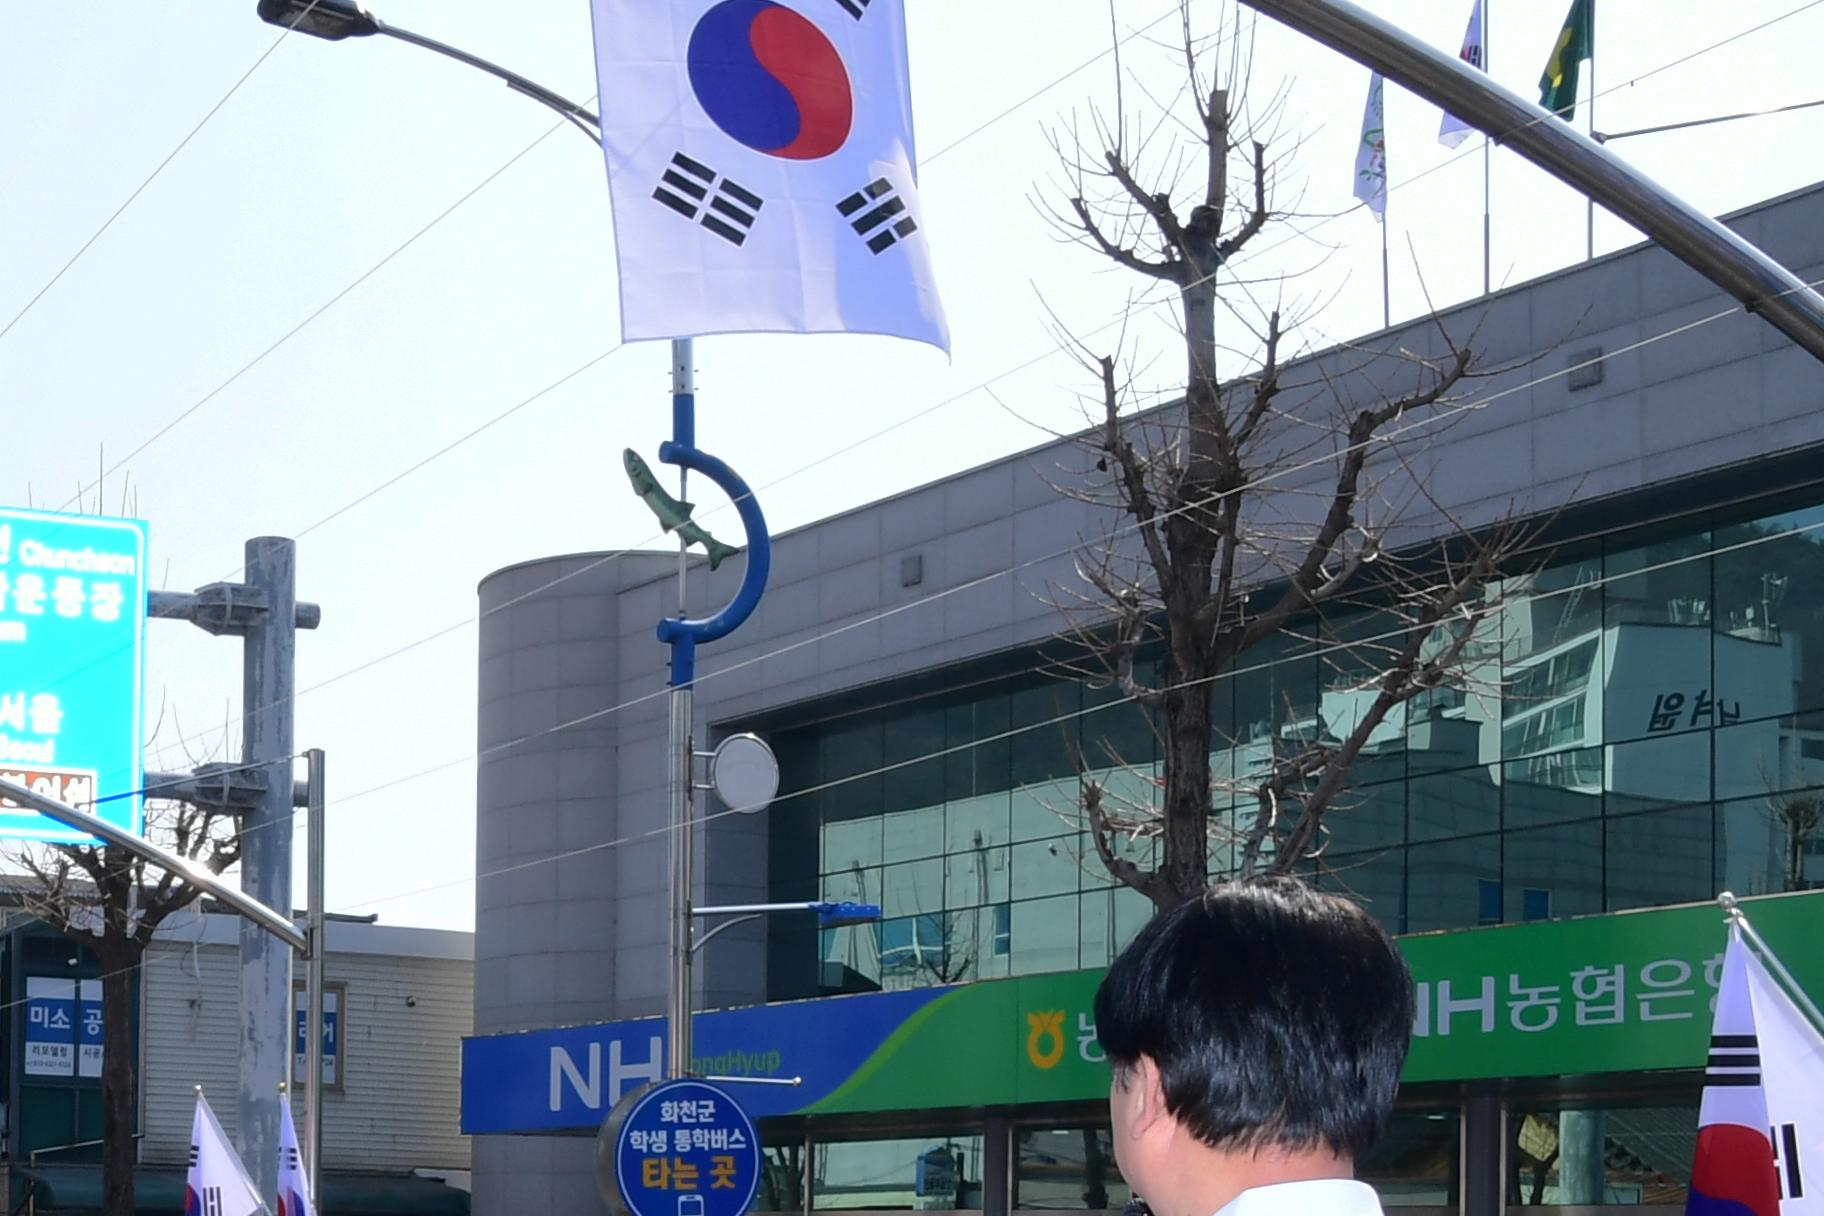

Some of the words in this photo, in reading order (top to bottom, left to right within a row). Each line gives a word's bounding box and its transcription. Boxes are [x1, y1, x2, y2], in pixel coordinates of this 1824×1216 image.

[30, 1005, 71, 1029] 미소
[549, 1036, 663, 1111] NH
[660, 1100, 716, 1123] 화천군
[629, 1129, 668, 1153] 학생
[673, 1128, 747, 1153] 통학버스
[642, 1156, 699, 1190] 타는
[710, 1155, 737, 1189] 곳
